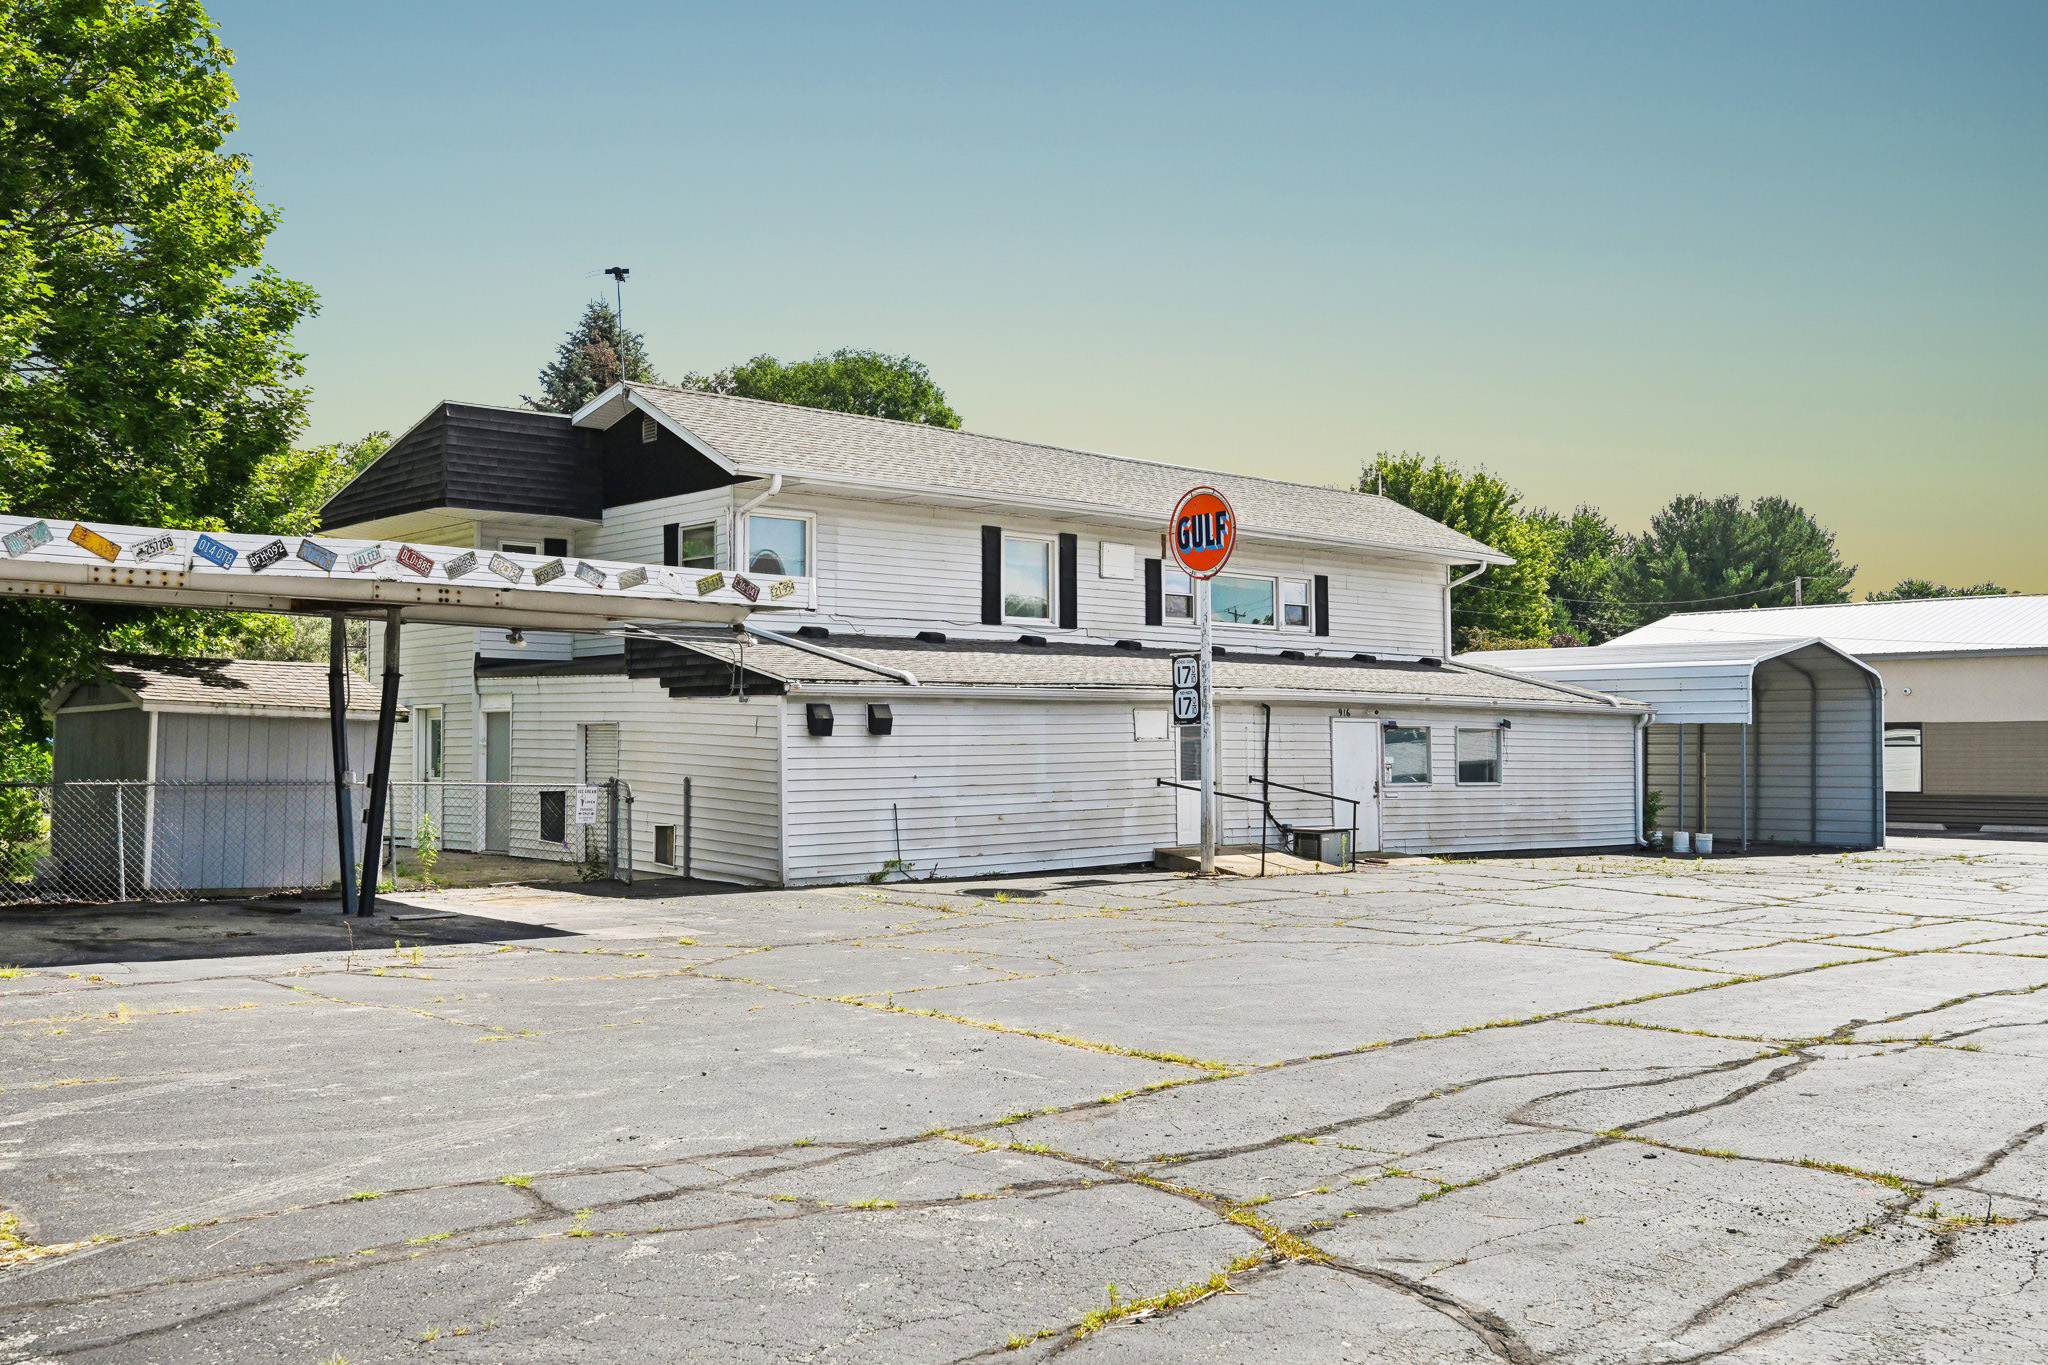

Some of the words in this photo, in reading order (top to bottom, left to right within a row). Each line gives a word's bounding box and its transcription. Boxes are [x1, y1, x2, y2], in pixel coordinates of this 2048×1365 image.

[1178, 511, 1228, 552] GULF
[145, 537, 174, 555] 257258
[1177, 666, 1191, 684] 17
[1178, 697, 1192, 715] 17
[1338, 708, 1351, 717] 916
